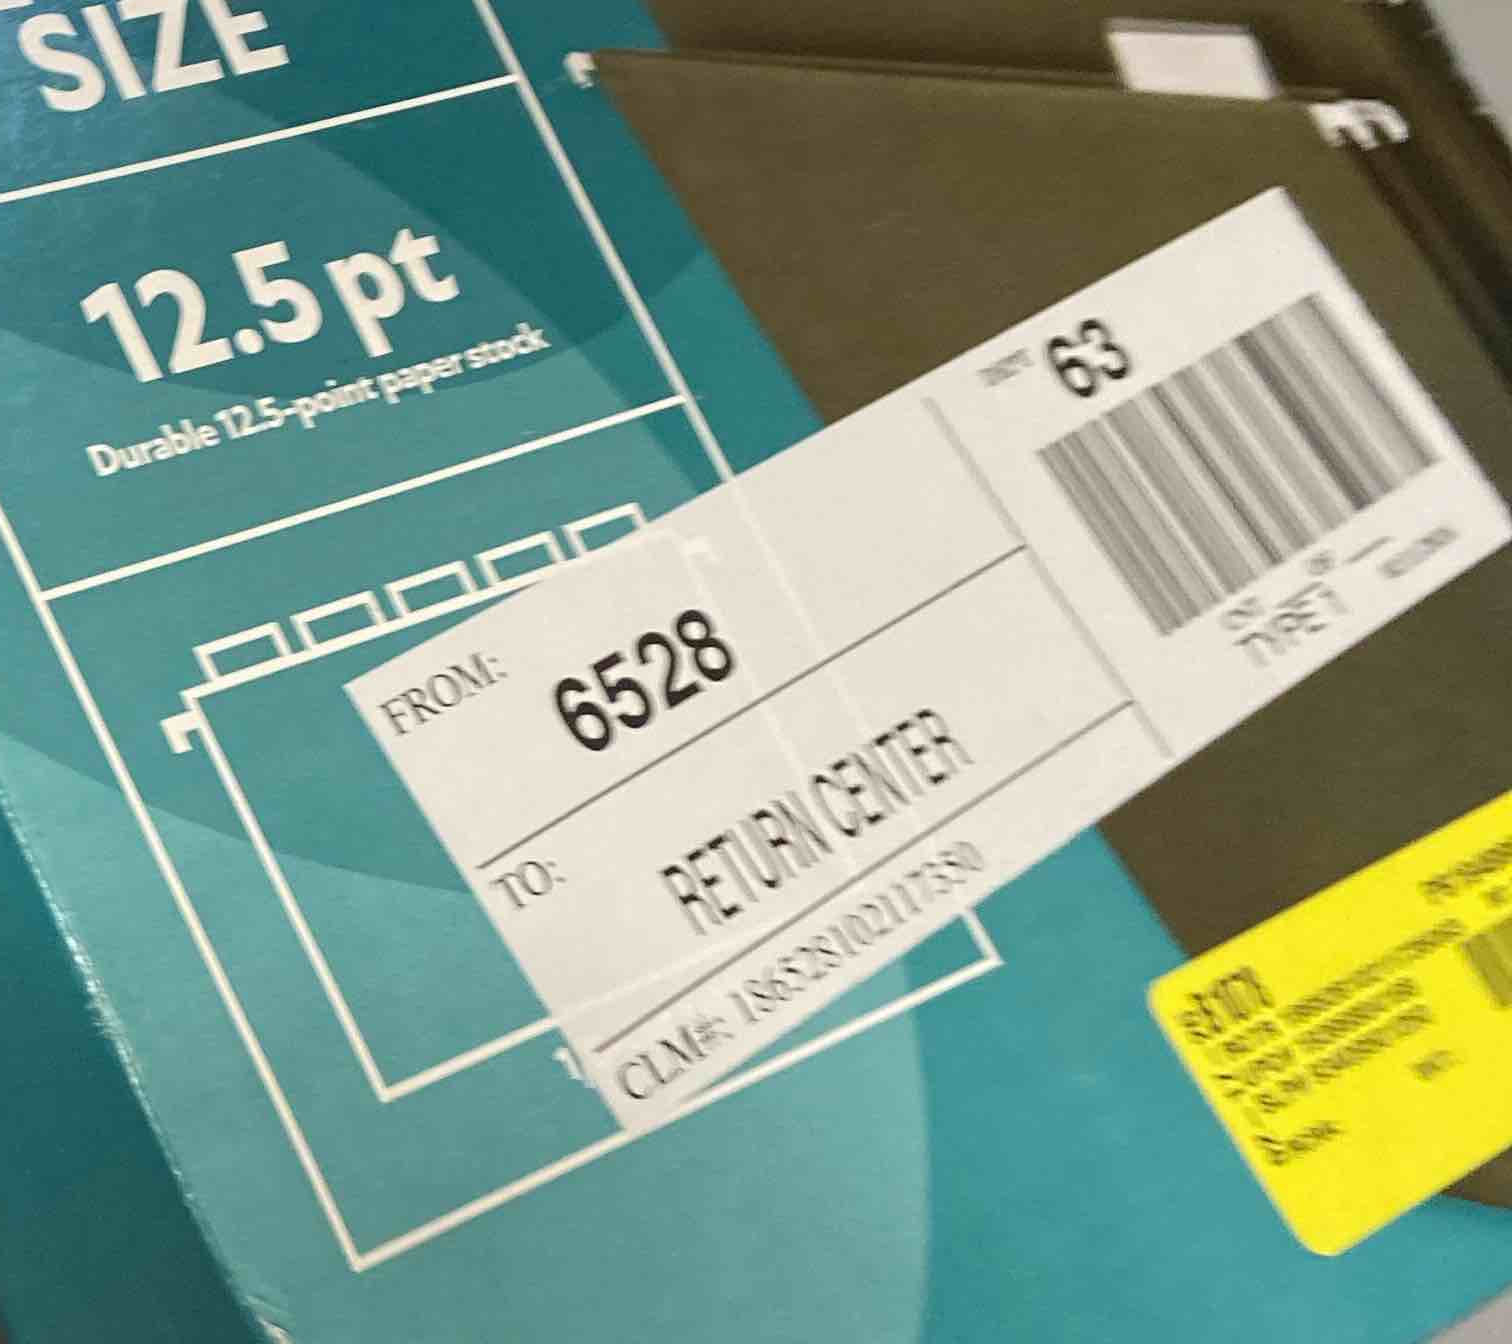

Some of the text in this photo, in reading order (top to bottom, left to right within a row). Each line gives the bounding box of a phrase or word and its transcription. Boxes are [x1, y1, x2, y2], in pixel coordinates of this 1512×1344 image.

[79, 227, 462, 384] 12.5 pt
[1048, 318, 1131, 398] 63
[85, 321, 553, 477] Durable 12.5-point paper stock
[377, 608, 736, 752] FROM: 6528
[489, 708, 977, 937] TO: RETURN CENTER
[615, 1013, 737, 1102] CLM#:
